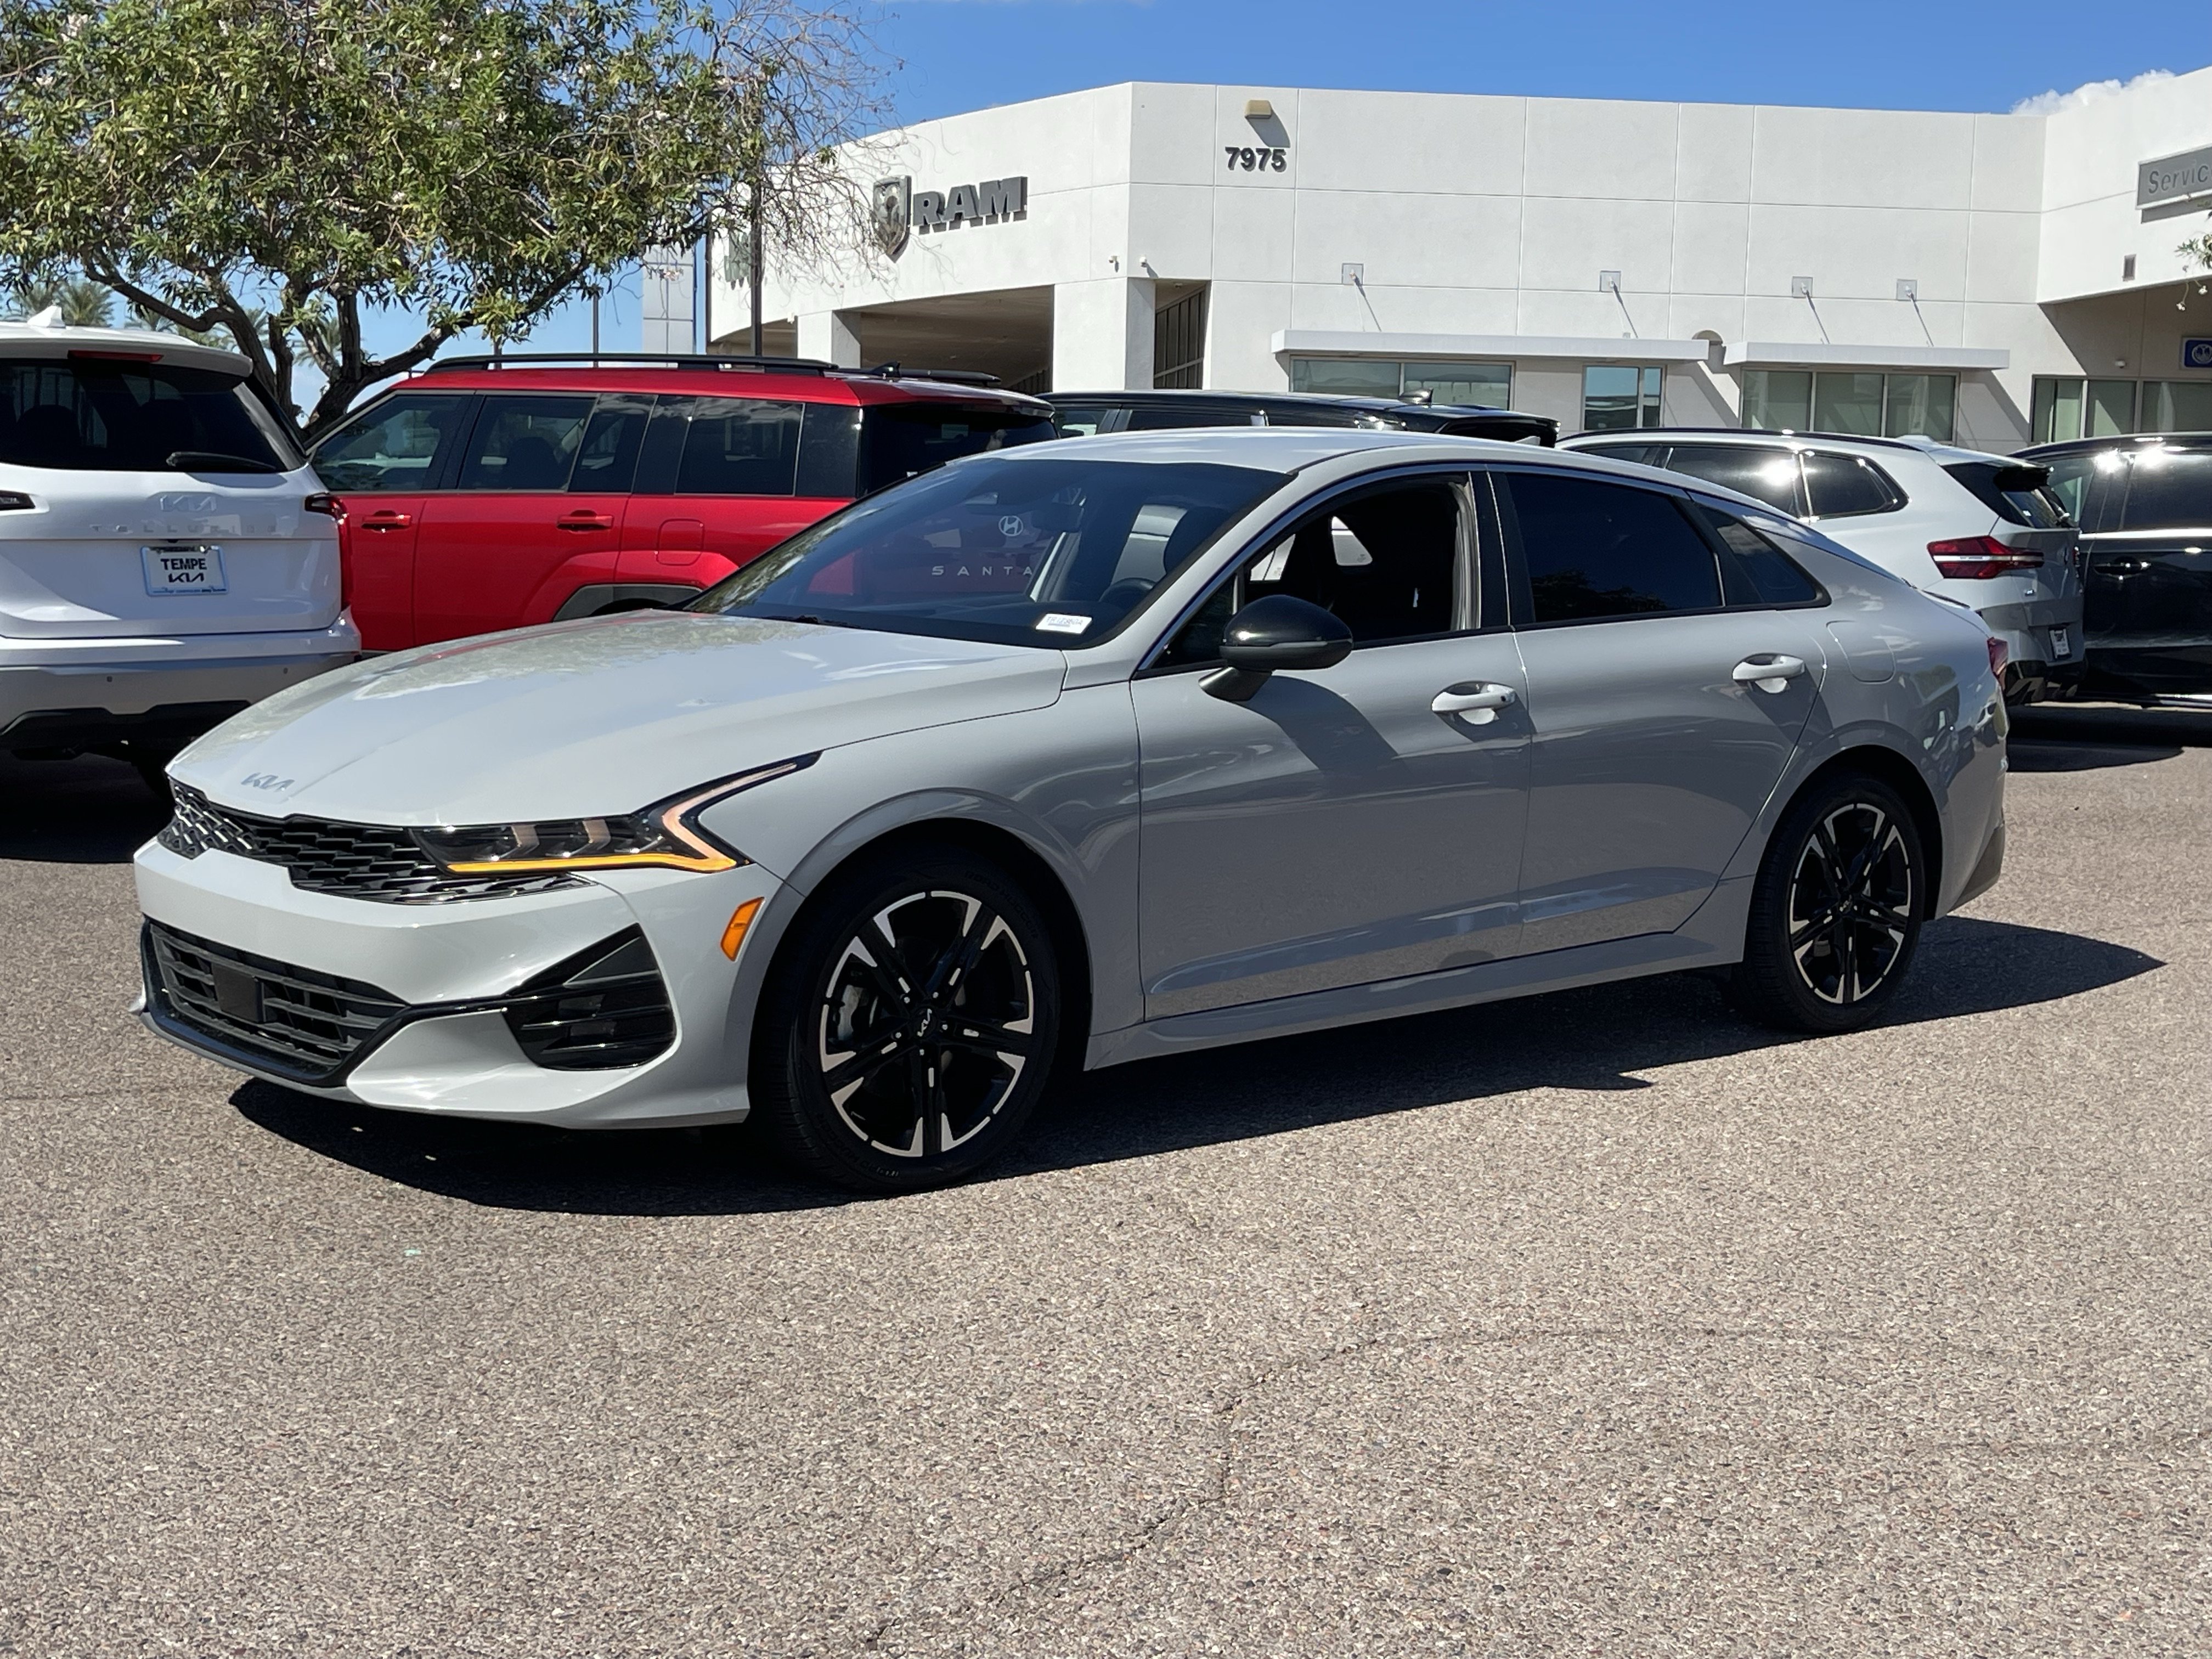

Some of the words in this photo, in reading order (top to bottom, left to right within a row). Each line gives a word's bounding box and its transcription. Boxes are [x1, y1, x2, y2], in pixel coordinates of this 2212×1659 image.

[1224, 146, 1287, 172] 7975
[2148, 165, 2212, 194] Servic
[913, 176, 1028, 228] RAM
[160, 557, 207, 571] TEMPE
[932, 565, 1033, 577] SANTA
[167, 572, 205, 583] KIA
[240, 772, 296, 792] KIA
